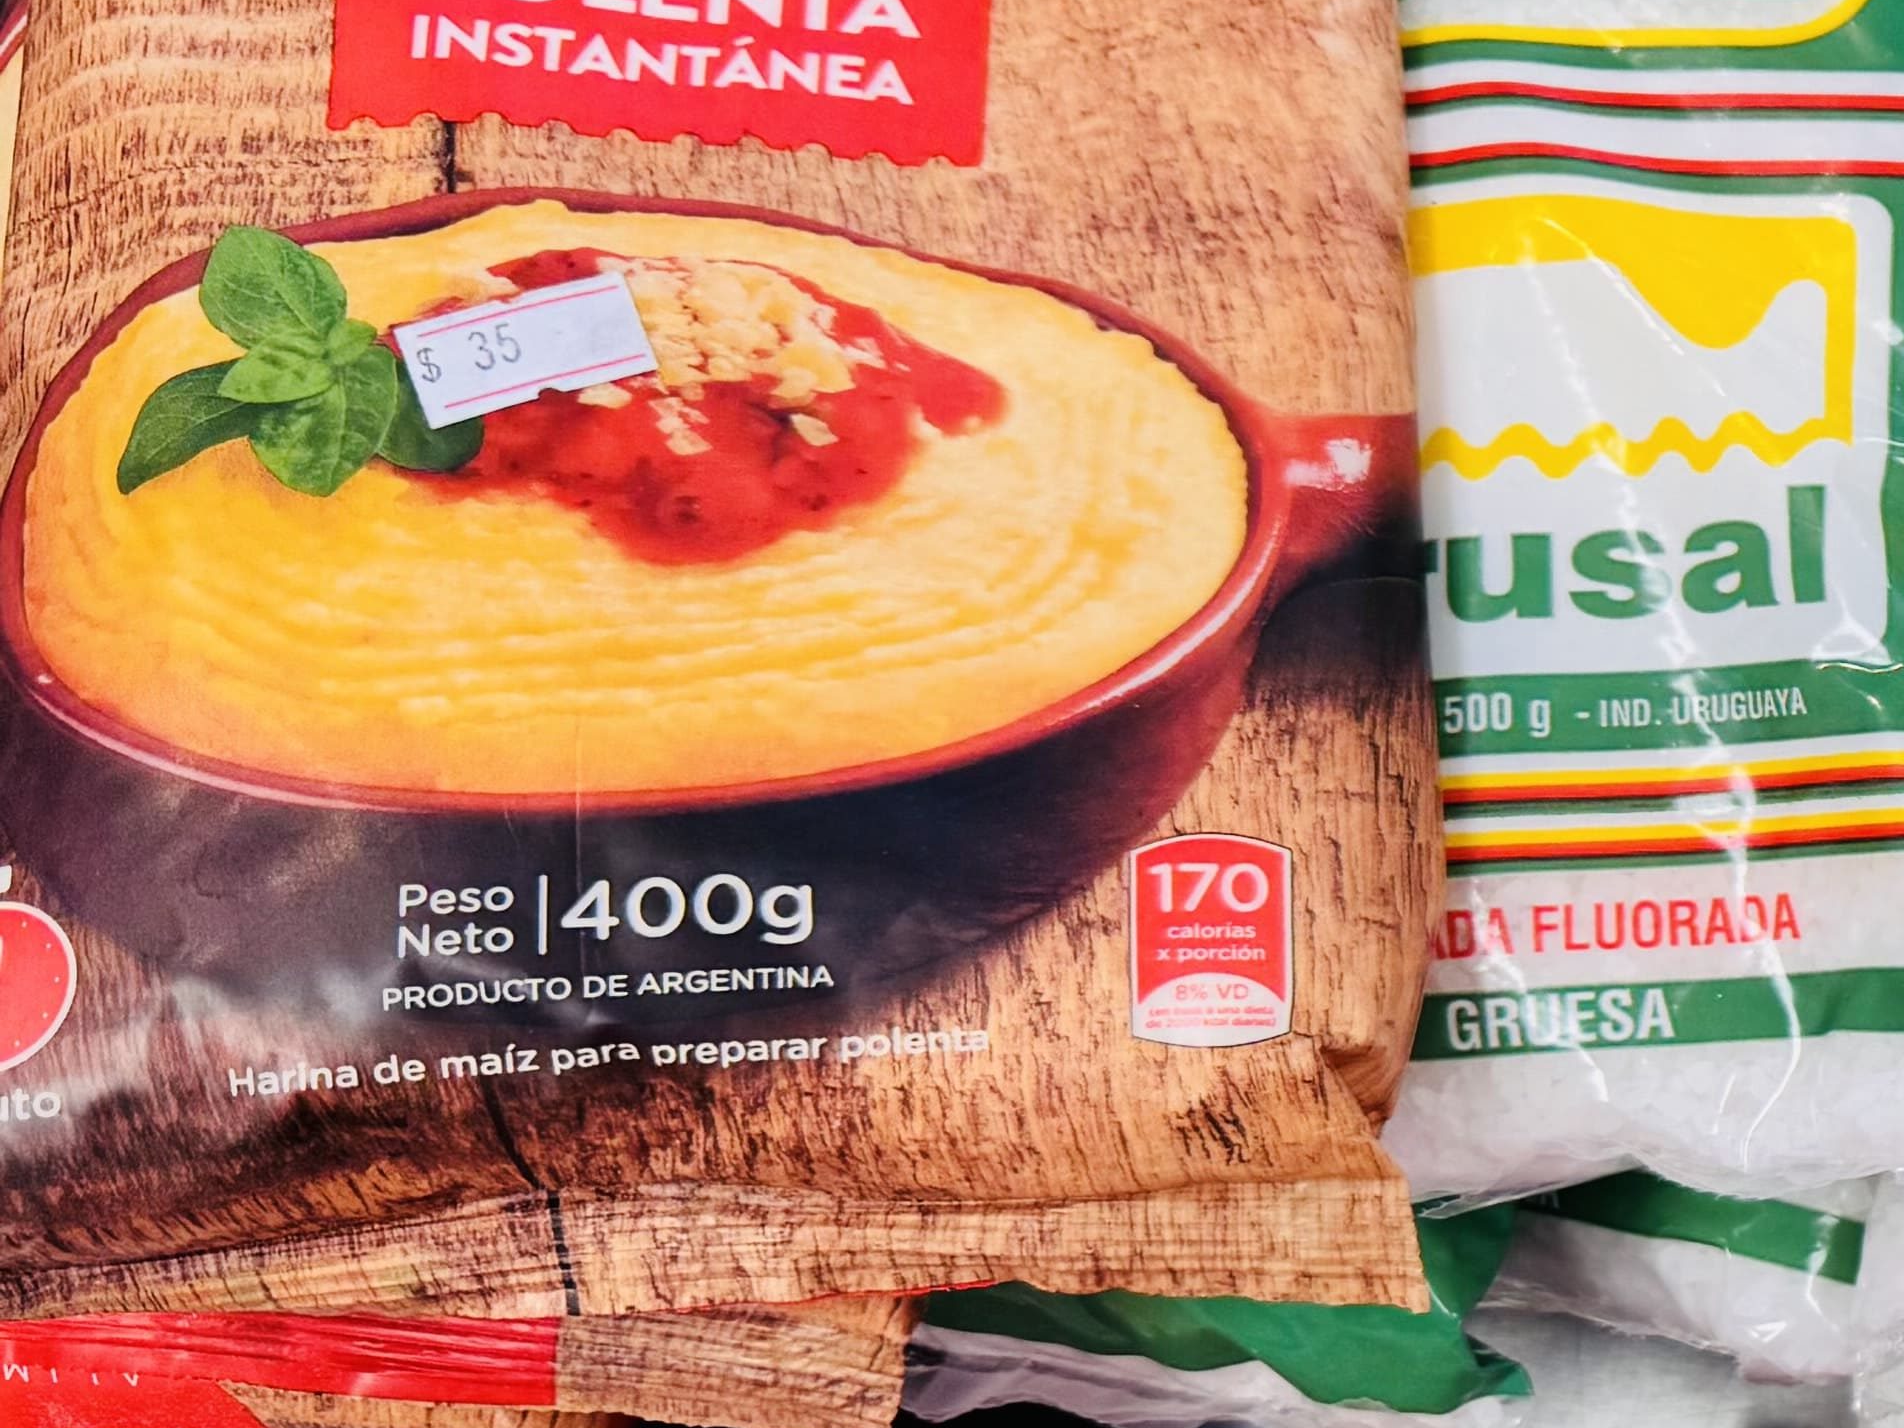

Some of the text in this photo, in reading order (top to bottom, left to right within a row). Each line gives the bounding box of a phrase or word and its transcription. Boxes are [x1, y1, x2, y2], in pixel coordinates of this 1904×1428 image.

[409, 11, 915, 107] INSTANTÁNEA
[467, 323, 522, 373] 35
[1442, 685, 1808, 741] 500 g IND. URUGUAYA
[396, 872, 817, 947] Peso 400g
[1148, 862, 1270, 913] 170
[396, 917, 517, 960] Neto
[1167, 922, 1257, 940] calorías
[1531, 892, 1802, 954] FLUORADA
[1156, 944, 1266, 963] x porción
[381, 964, 836, 1014] PRODUCTO DE ARGENTINA
[1216, 983, 1249, 1000] VD
[1445, 987, 1676, 1054] GRUESA
[227, 1021, 991, 1100] Harina de maíz para preparar polenta
